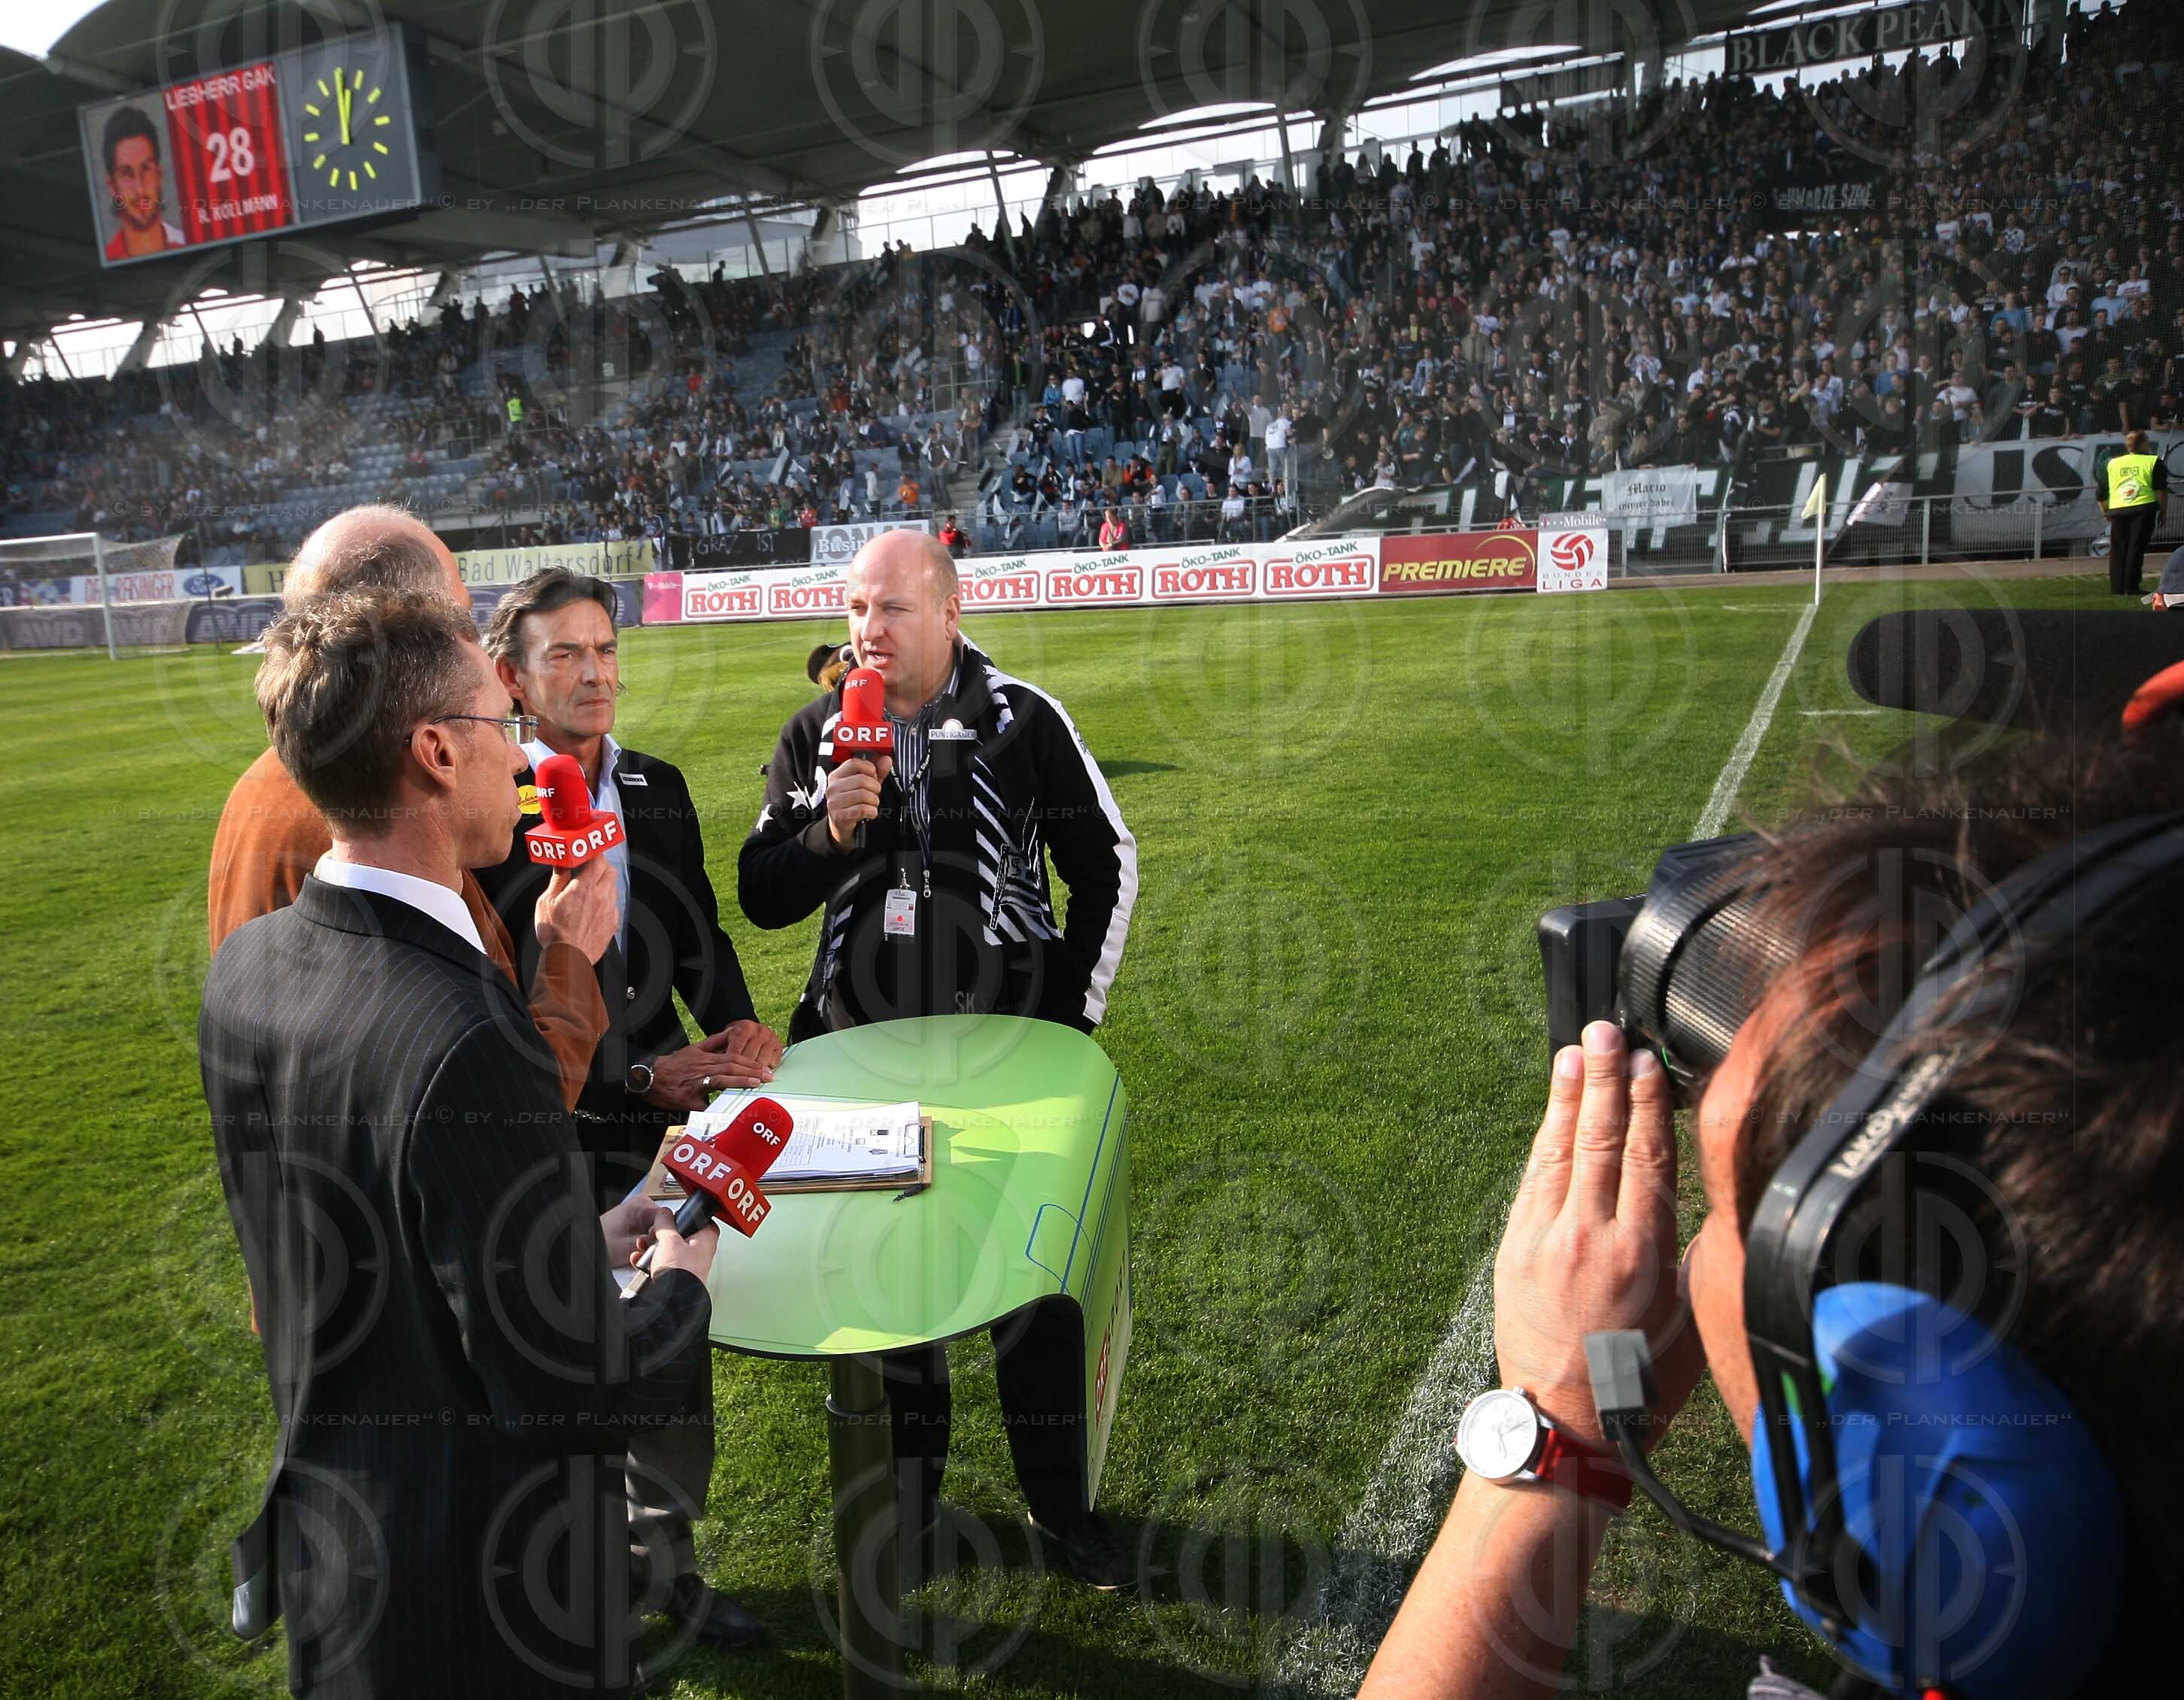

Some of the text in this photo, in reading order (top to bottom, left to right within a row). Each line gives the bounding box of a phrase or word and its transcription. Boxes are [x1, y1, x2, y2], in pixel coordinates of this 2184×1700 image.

[1733, 17, 1867, 73] BLACK
[165, 64, 276, 111] LIEBHERR GAK
[206, 126, 255, 184] 28
[1628, 482, 1667, 495] Mario
[1073, 553, 1130, 575] ÖKO-TANK
[1181, 546, 1241, 569] ÖKO-TANK
[1295, 541, 1358, 564] ÖKO-TANK
[458, 556, 496, 582] Bad
[791, 568, 839, 588] ÖKO-TANK
[975, 558, 1027, 578] ÖKO-TANK
[1158, 566, 1249, 593] ROTH
[1270, 561, 1368, 588] ROTH
[1382, 557, 1527, 582] PREMIERE
[1542, 570, 1603, 579] BUNDES
[707, 573, 752, 591] ÖKO-TANK
[958, 576, 1034, 600] ROTH
[1051, 572, 1137, 597] ROTH
[1542, 578, 1603, 590] LIGA
[690, 590, 758, 612] ROTH
[774, 586, 847, 609] ROTH
[845, 679, 867, 690] ORF
[838, 727, 889, 742] ORF
[536, 787, 555, 798] ORF
[529, 839, 566, 860] ORF
[572, 820, 618, 858] ORF
[955, 991, 975, 1015] SK
[753, 1122, 781, 1146] ORF
[673, 1143, 732, 1180] ORF
[727, 1178, 766, 1222] ORF
